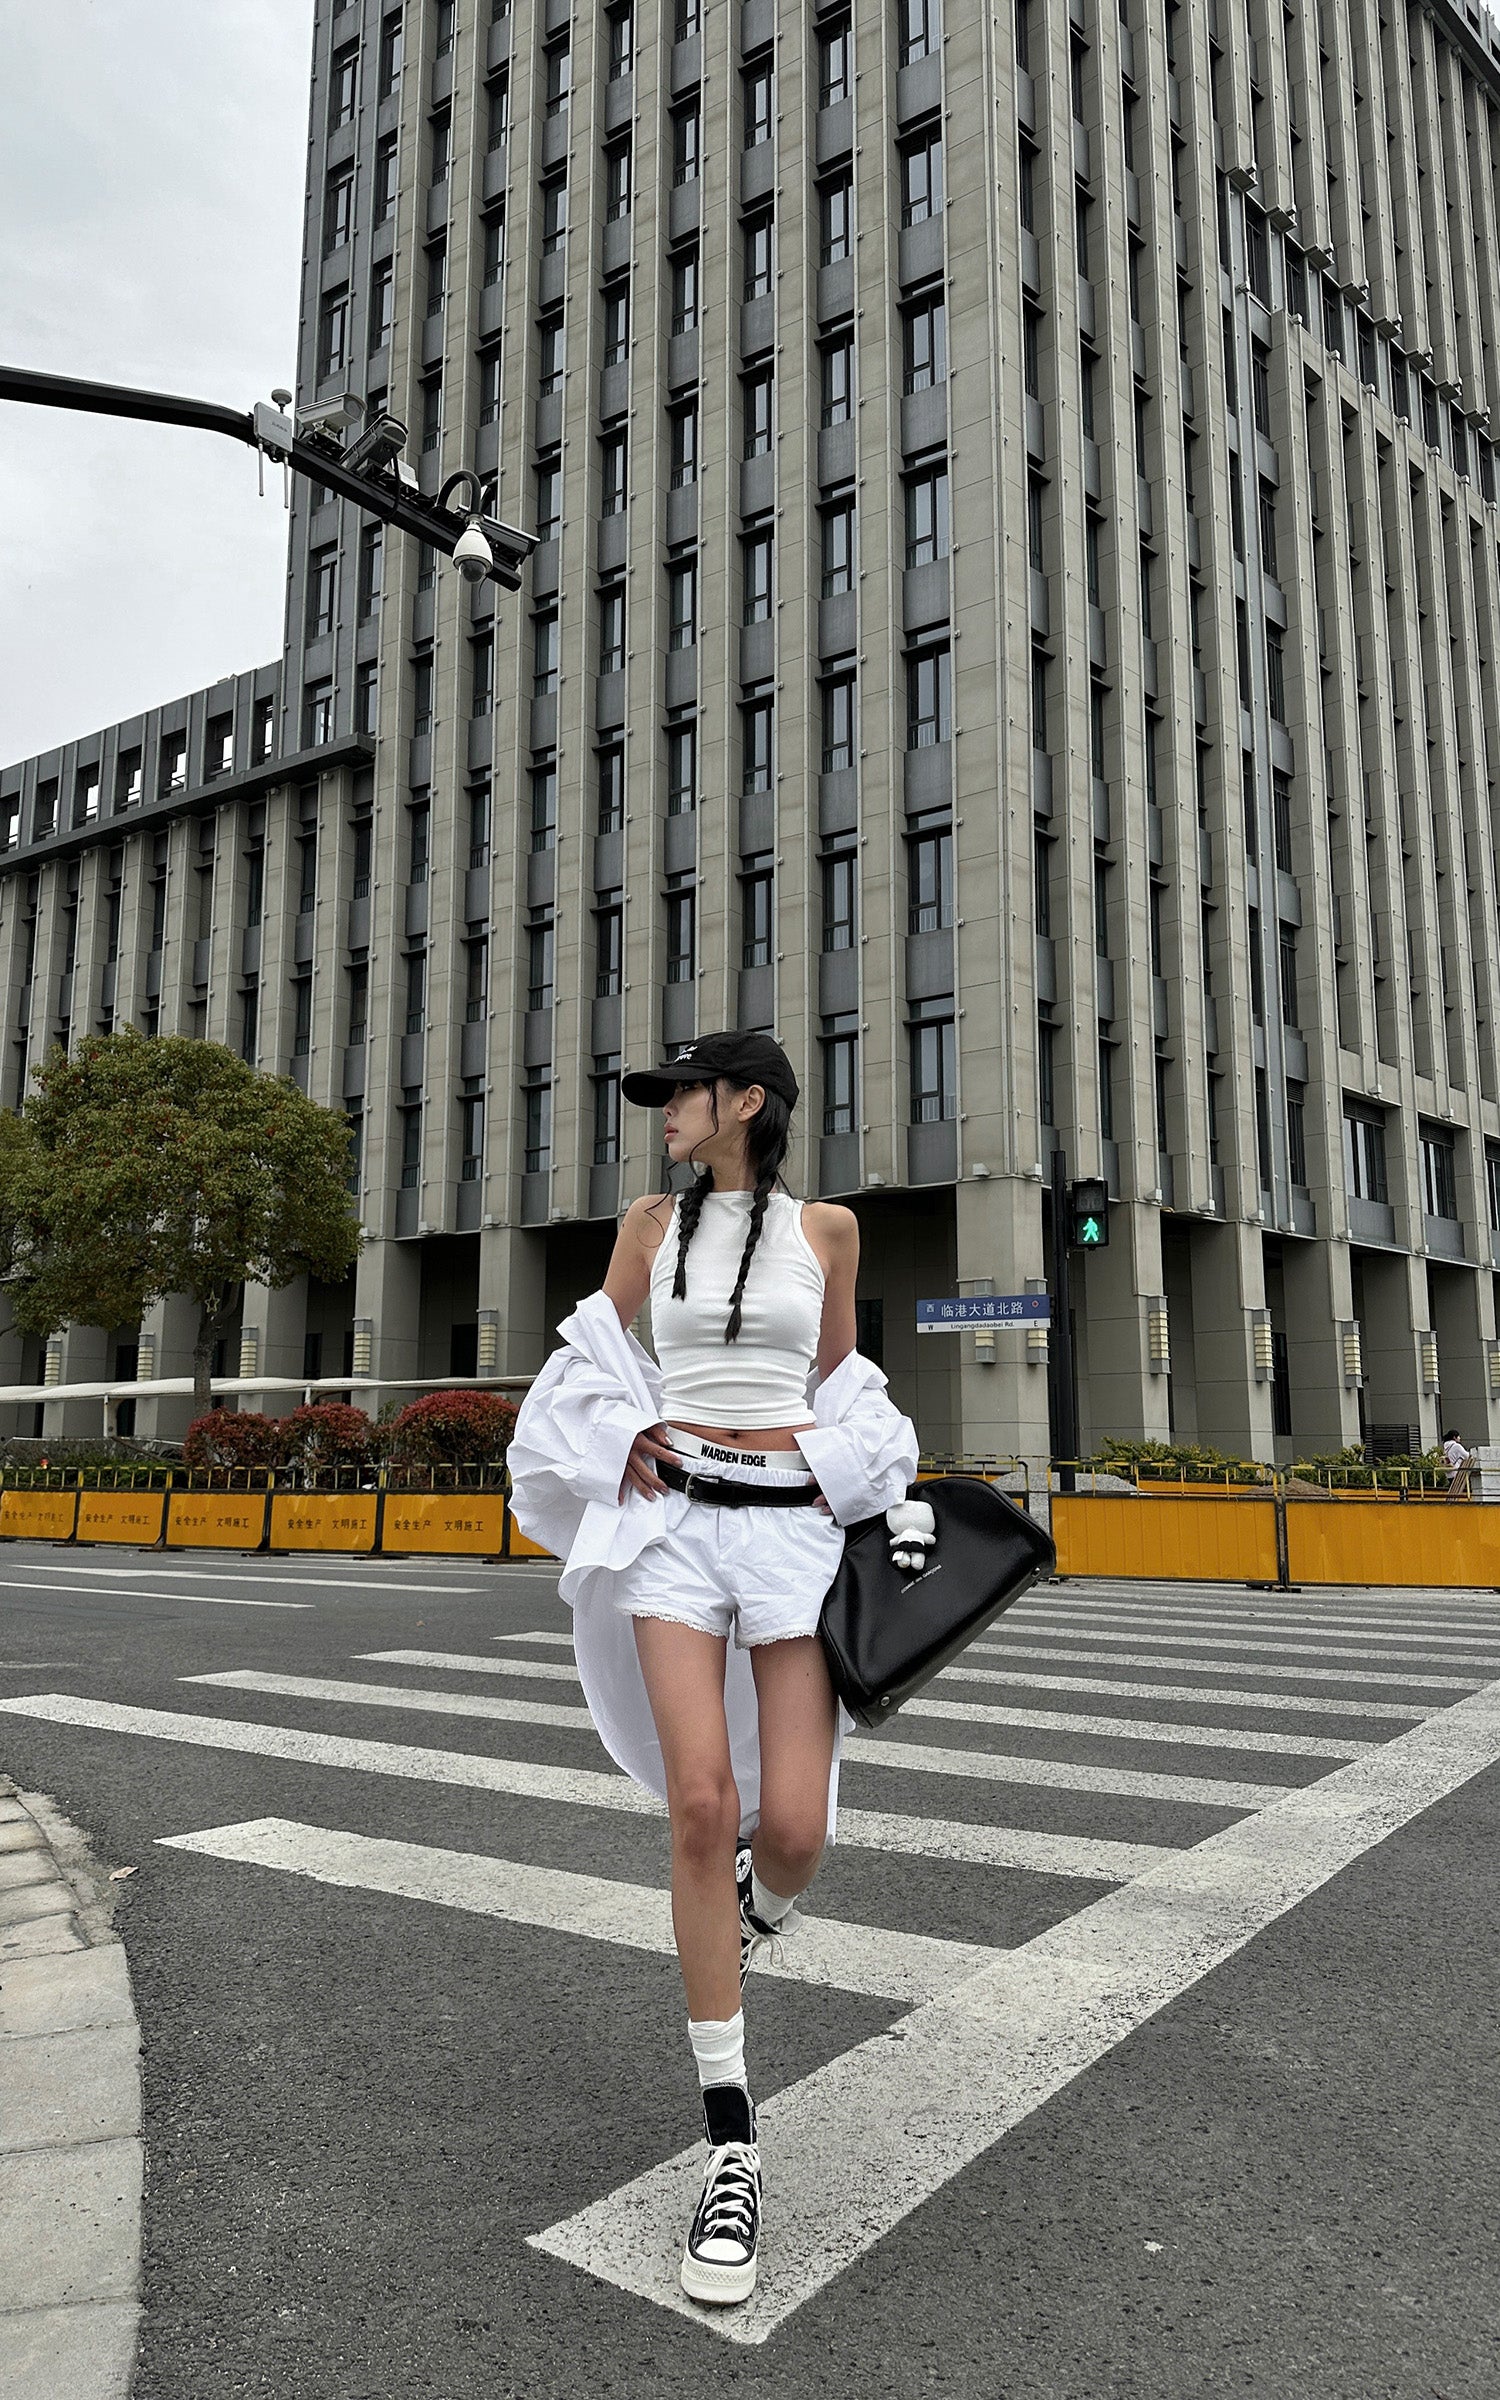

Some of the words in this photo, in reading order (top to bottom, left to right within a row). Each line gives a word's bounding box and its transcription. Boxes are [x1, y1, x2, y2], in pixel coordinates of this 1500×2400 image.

[941, 1301, 1024, 1318] 临港大道北路
[700, 1443, 739, 1464] WARDEN
[740, 1453, 767, 1468] EDGE
[175, 1515, 207, 1527] 安全生产
[287, 1518, 323, 1530] 安全生产
[332, 1518, 367, 1530] 文明施工
[393, 1519, 431, 1531] 安全生产
[444, 1519, 484, 1532] 文明施工
